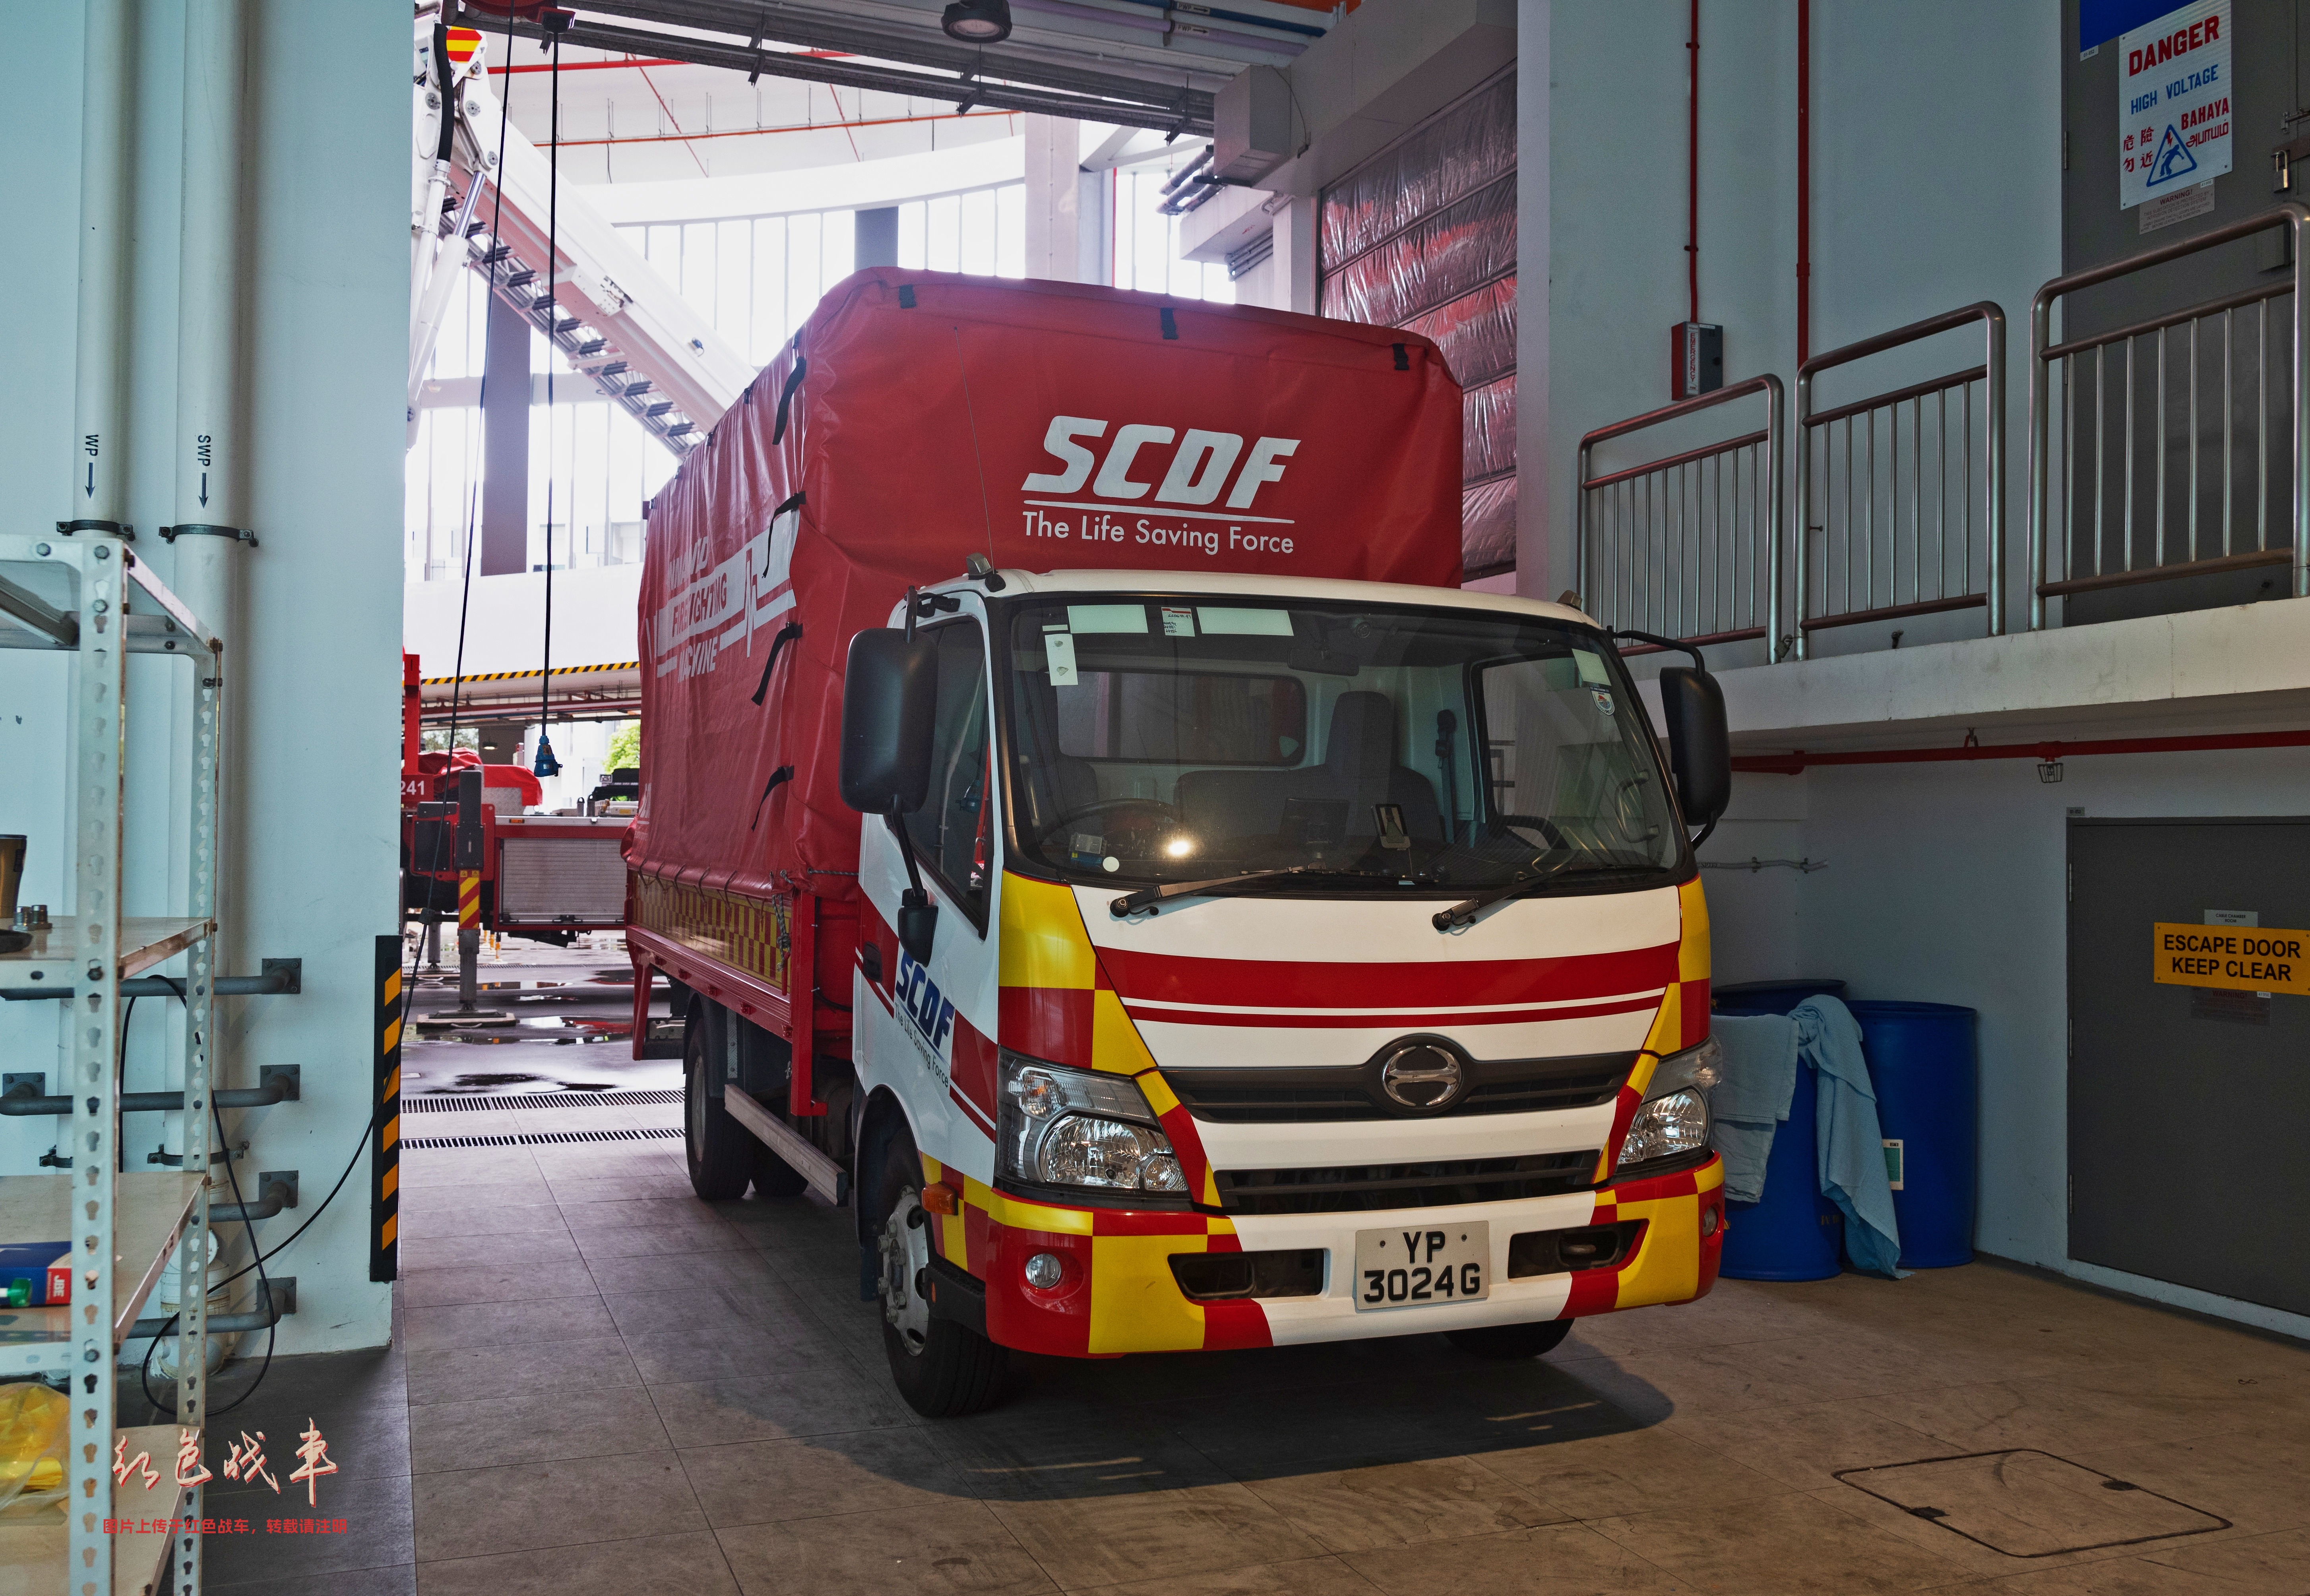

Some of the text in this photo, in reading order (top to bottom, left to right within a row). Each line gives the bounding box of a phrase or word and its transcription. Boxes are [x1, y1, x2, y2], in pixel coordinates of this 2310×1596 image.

[2129, 15, 2219, 77] DANGER
[2131, 64, 2218, 115] HIGH VOLTAGE
[2181, 97, 2229, 130] BAHAYA
[2123, 126, 2155, 153] 危險
[2122, 151, 2153, 172] 勿近
[2160, 189, 2192, 205] WARNING!
[2167, 201, 2189, 213] DETECTION
[2190, 196, 2206, 205] SYSTEM
[2180, 192, 2203, 204] PROTECTED
[85, 434, 99, 456] WP
[198, 434, 211, 467] SWP
[1021, 415, 1301, 509] SCDF
[1023, 511, 1294, 555] The Life Saving Force
[401, 780, 424, 795] 241
[2164, 934, 2300, 959] ESCAPE DOOR
[2172, 957, 2291, 982] KEEP CLEAR
[895, 949, 955, 1050] SCDF
[2212, 990, 2247, 999] WARNING!
[895, 1003, 948, 1088] The Life Saving Force
[1403, 1231, 1446, 1263] YP
[53, 1274, 65, 1298] JBE
[1364, 1263, 1481, 1303] 3024G
